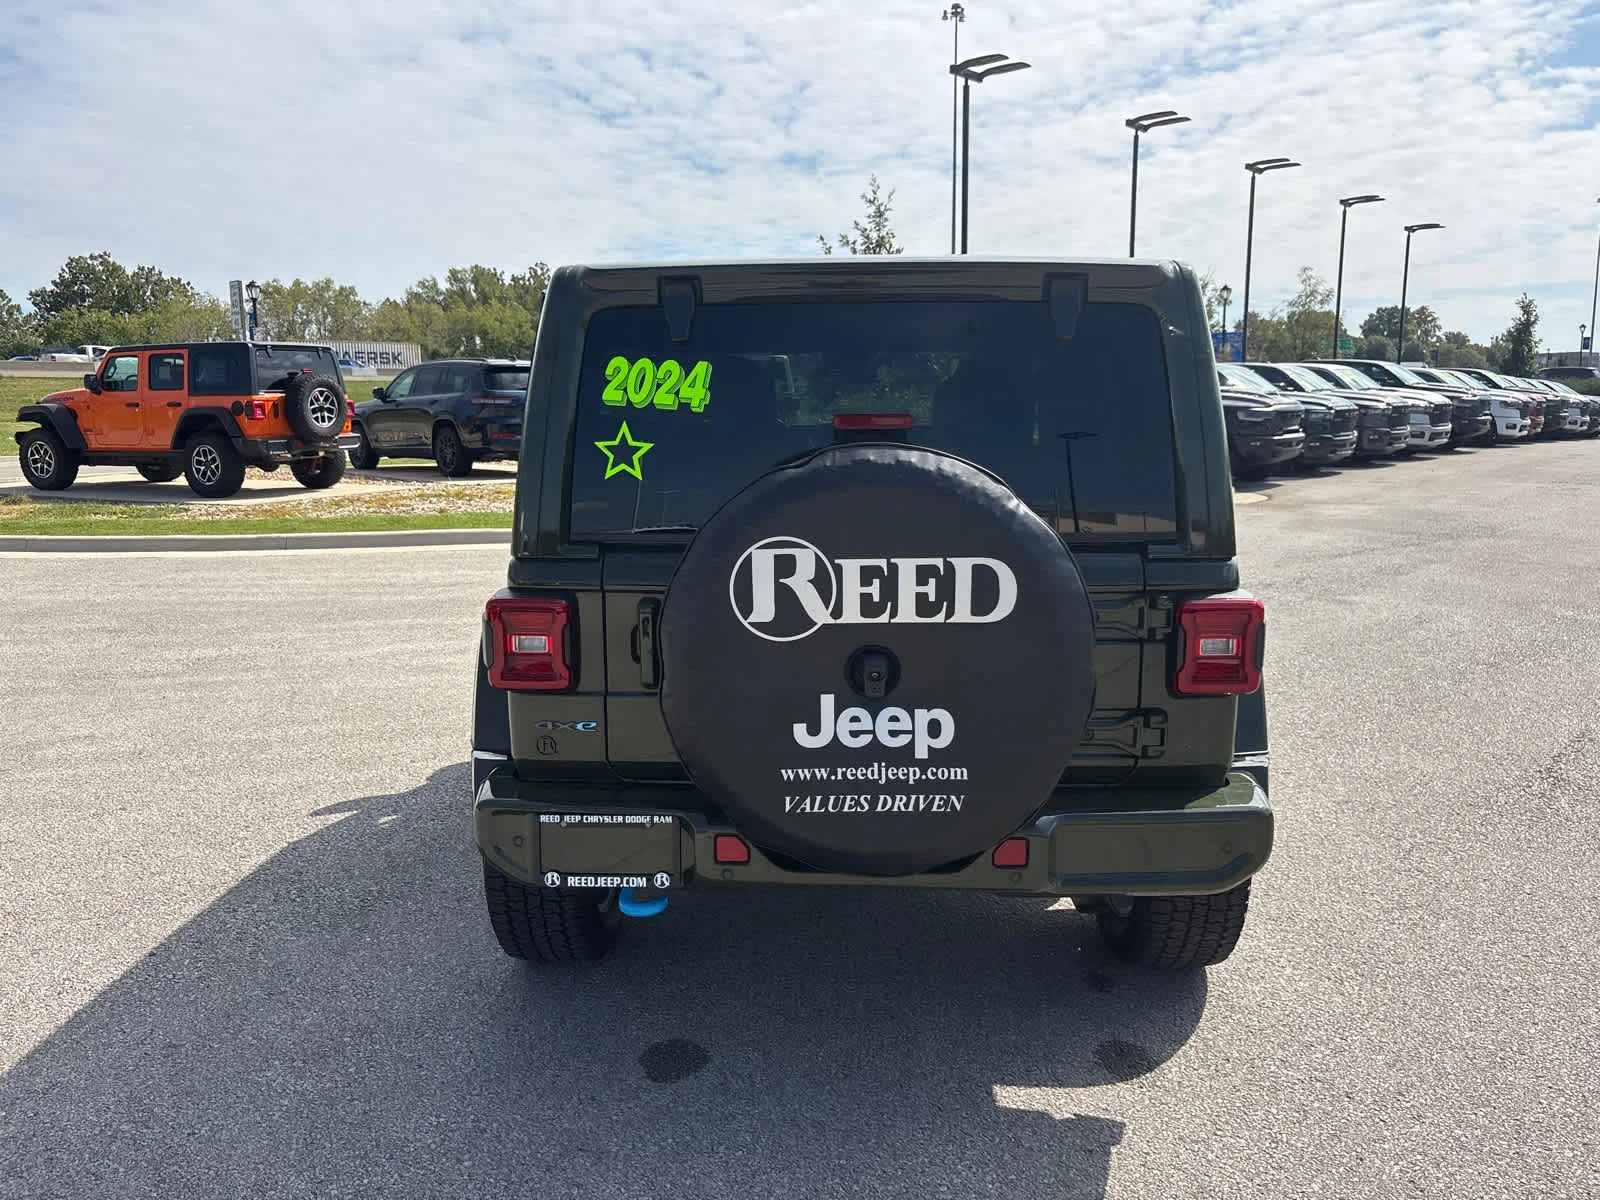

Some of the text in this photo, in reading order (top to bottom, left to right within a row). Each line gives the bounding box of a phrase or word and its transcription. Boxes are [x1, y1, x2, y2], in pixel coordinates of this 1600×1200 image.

[336, 351, 403, 365] AERSK
[602, 356, 713, 412] 2024
[743, 547, 1018, 624] REED
[793, 694, 955, 759] Jeep
[780, 762, 968, 785] www.reedjeep.com
[784, 795, 965, 813] VALUES DRIVEN
[540, 814, 673, 824] REED JEEP CHRYSLER DODGE RAM
[567, 876, 647, 888] REEDJEEP.COM
